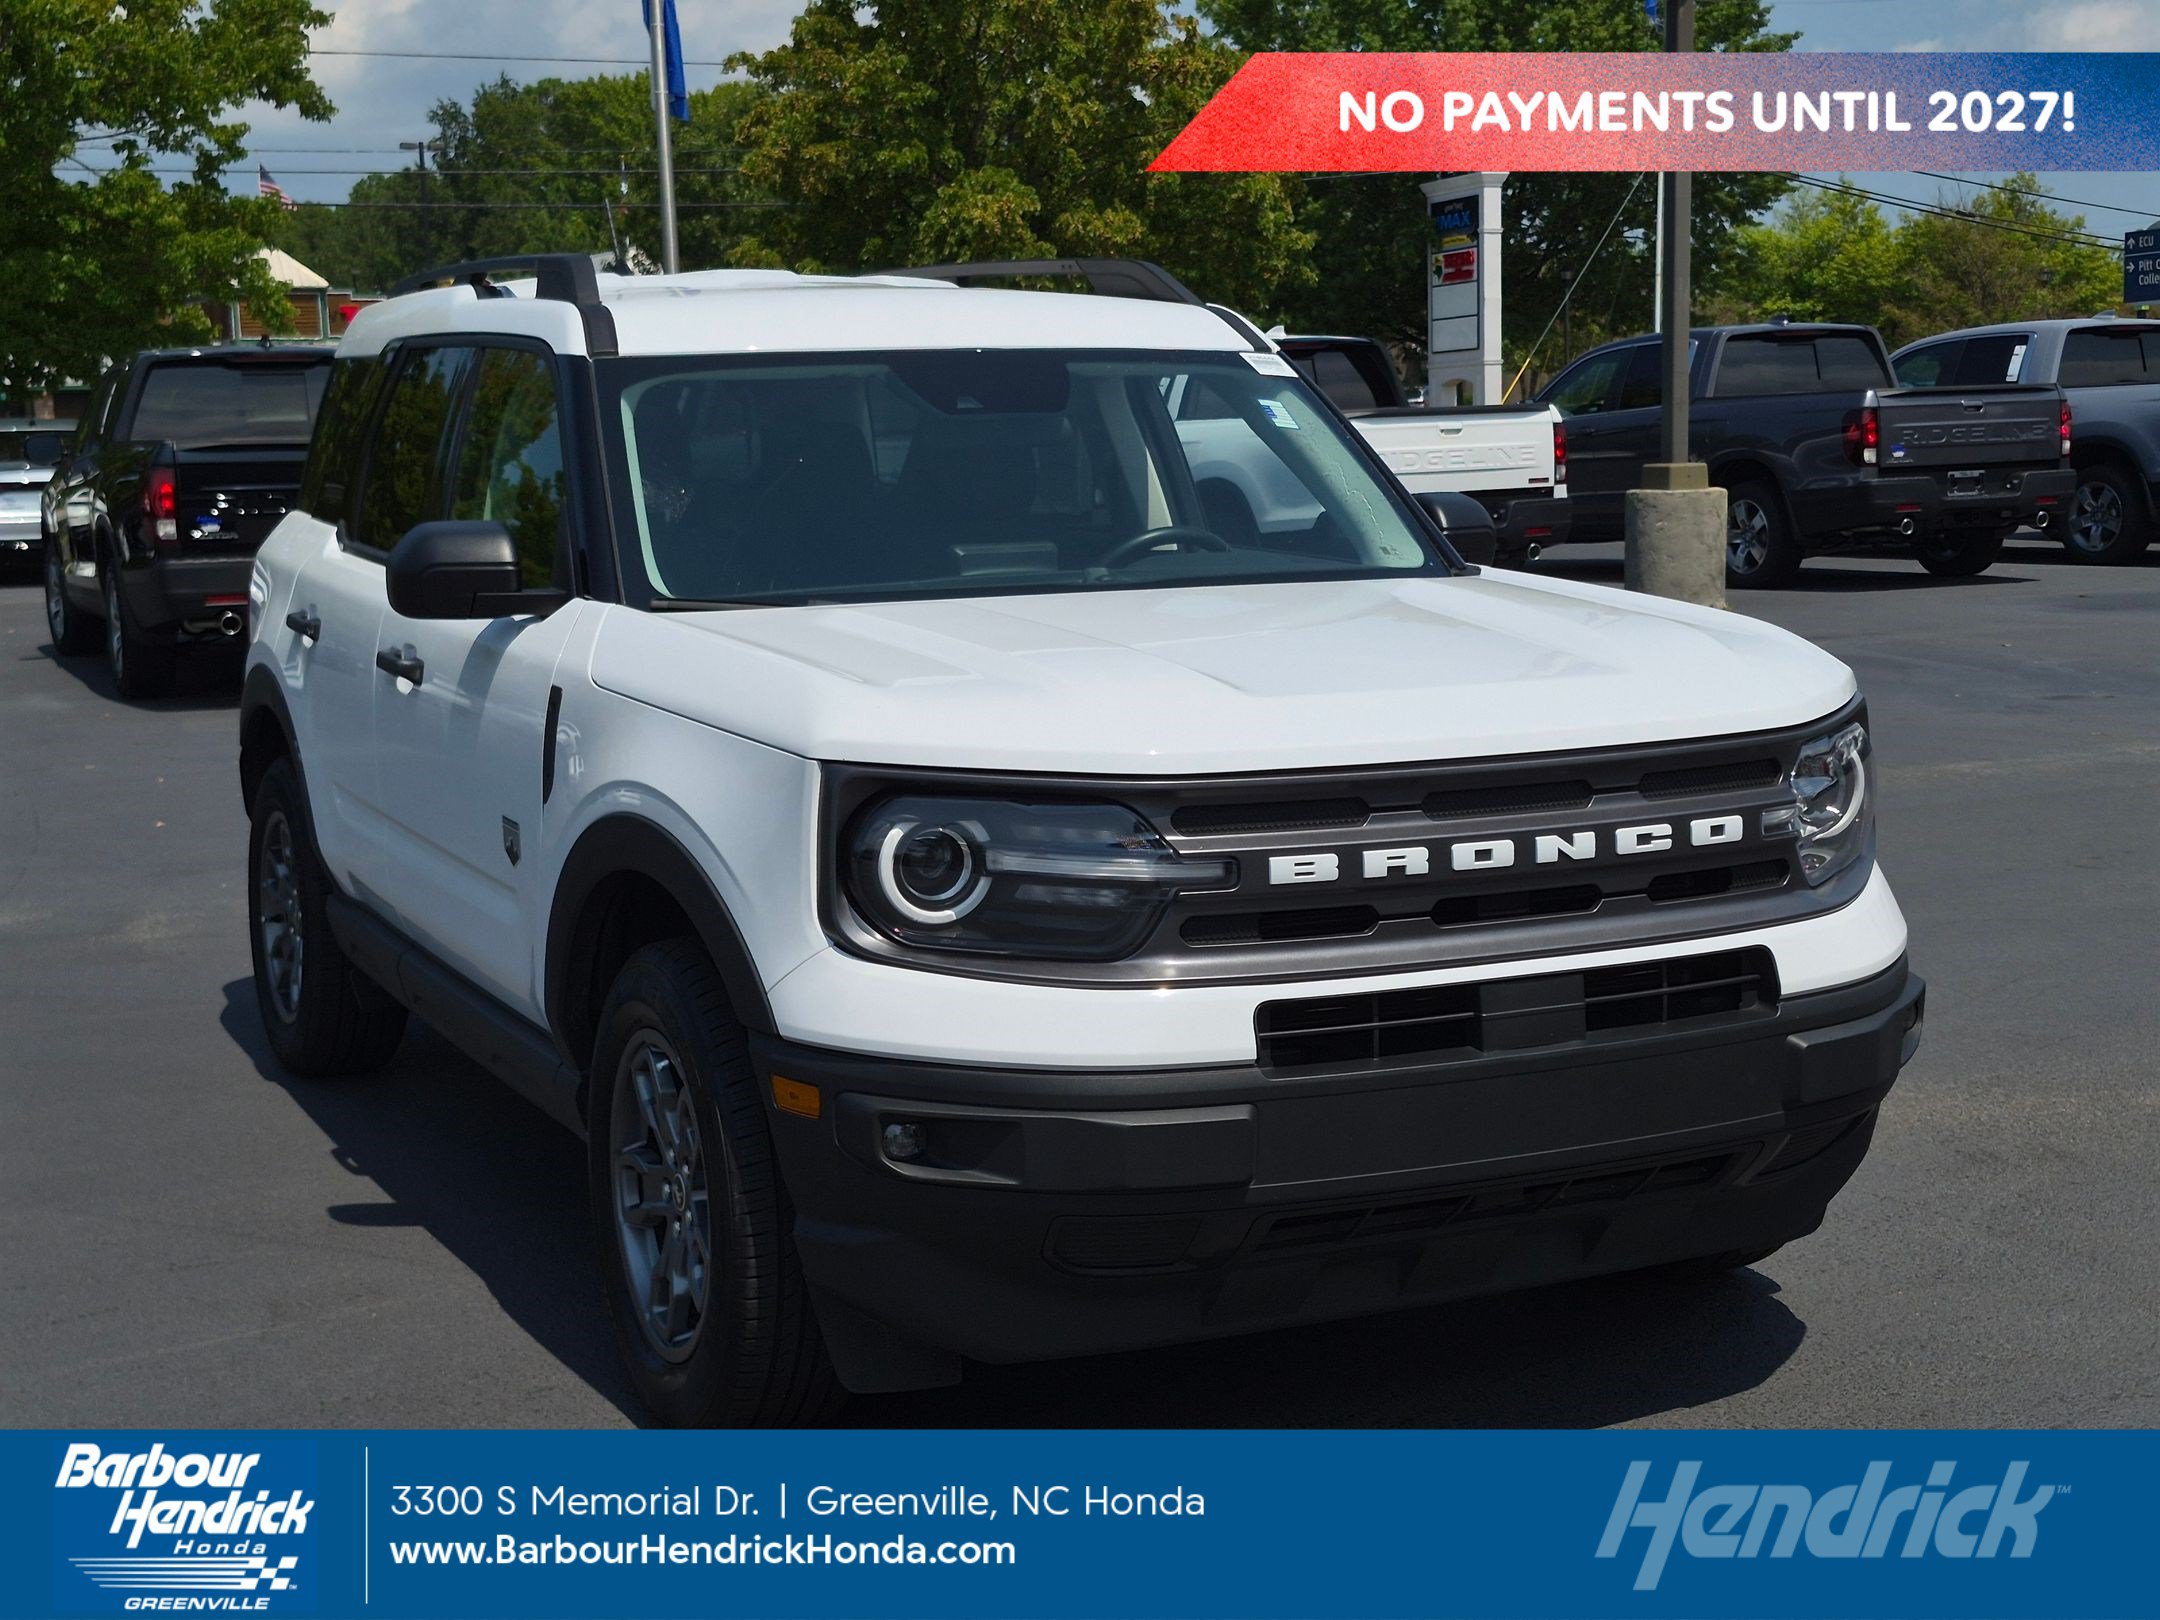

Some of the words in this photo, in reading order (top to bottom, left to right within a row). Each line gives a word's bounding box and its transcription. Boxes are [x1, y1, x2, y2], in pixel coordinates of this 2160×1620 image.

[2139, 235, 2154, 247] ECU
[2138, 260, 2153, 271] Pitt
[1268, 815, 1744, 885] BRONCO
